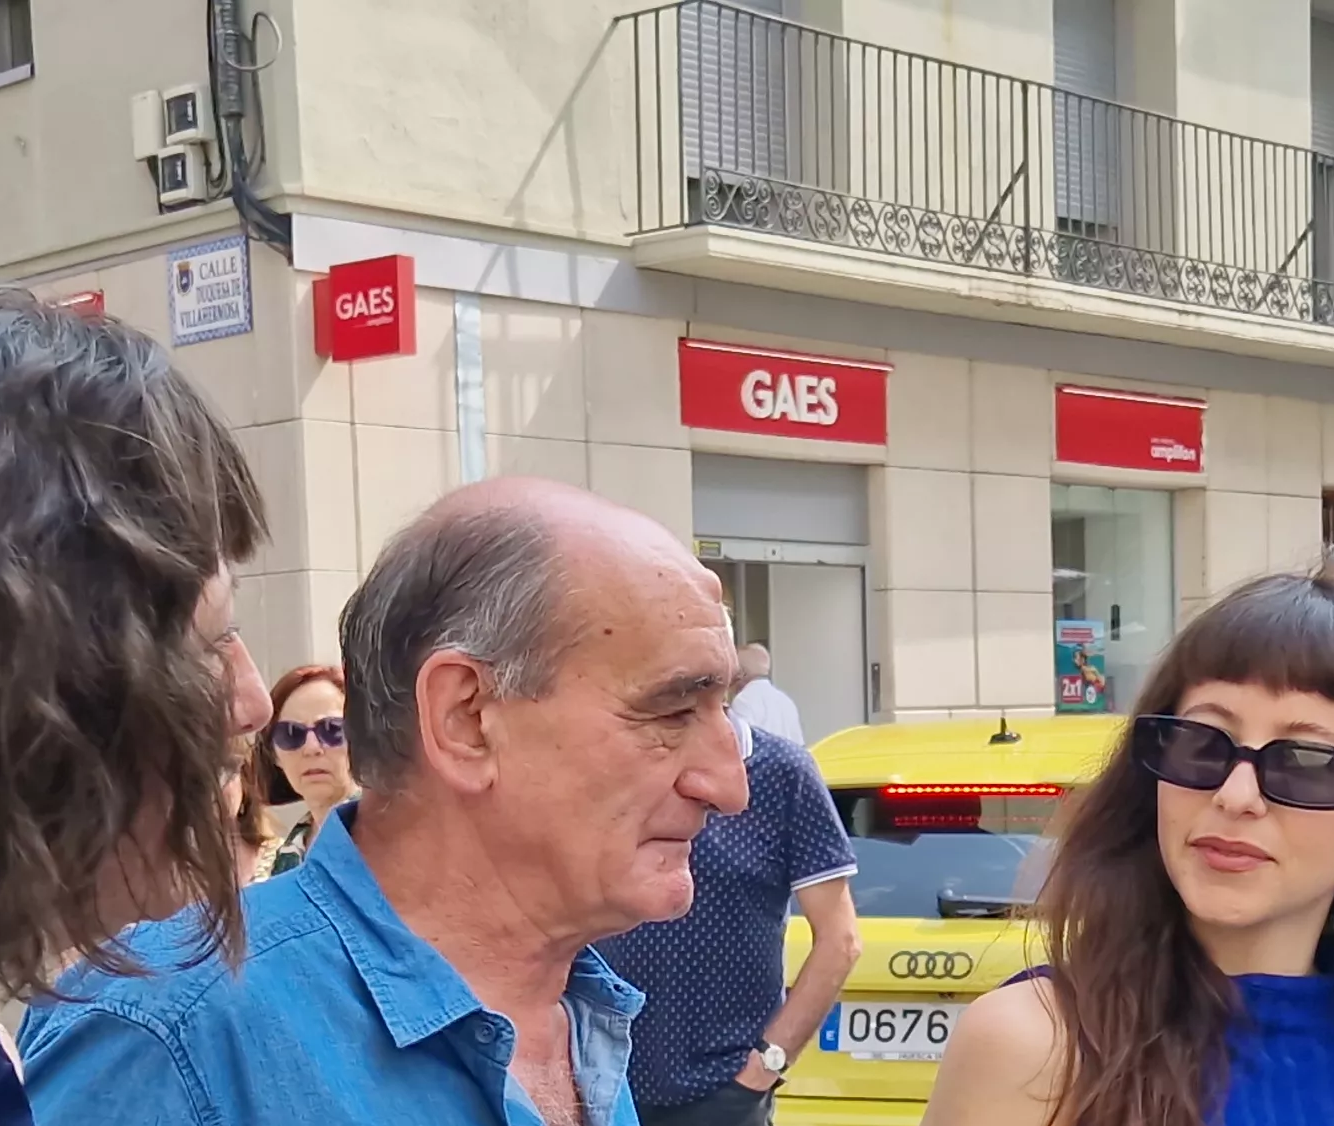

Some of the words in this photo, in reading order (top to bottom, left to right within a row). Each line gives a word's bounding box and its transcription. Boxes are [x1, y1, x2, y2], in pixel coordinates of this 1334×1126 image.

[199, 256, 238, 280] CALLE
[335, 286, 395, 320] GAES
[740, 369, 838, 426] GAES
[1063, 678, 1083, 697] 2x1
[825, 1030, 836, 1042] E
[848, 1008, 949, 1044] 0676
